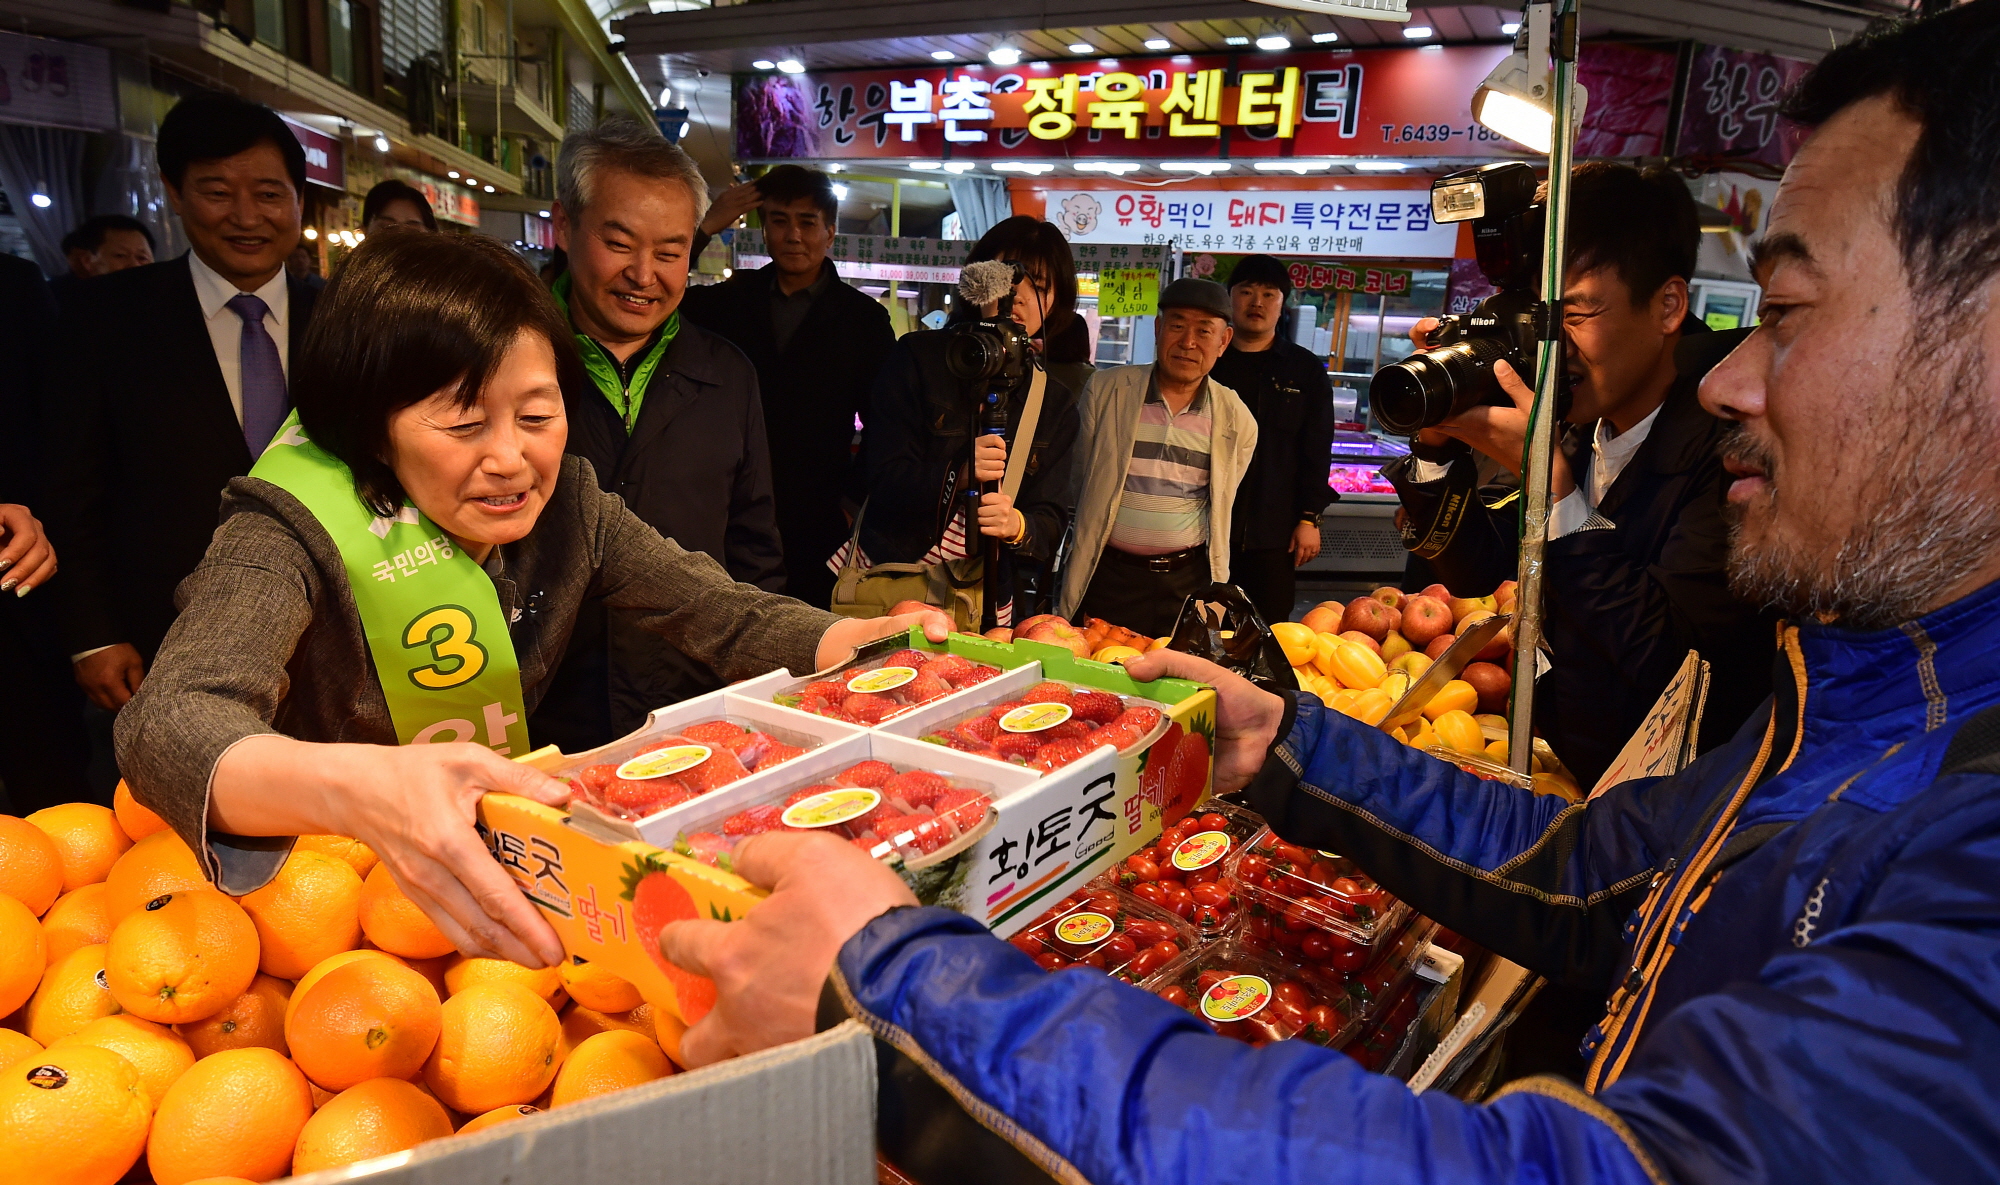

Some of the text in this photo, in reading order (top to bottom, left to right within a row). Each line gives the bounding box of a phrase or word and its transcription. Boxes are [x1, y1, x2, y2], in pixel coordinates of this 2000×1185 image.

[883, 75, 995, 142] 부촌
[1022, 66, 1300, 141] 정육센터
[1702, 57, 1780, 148] 한우
[1115, 194, 1431, 231] 유황먹인 돼지 특약전문점
[1232, 235, 1257, 251] 각종
[1263, 235, 1302, 251] 수입육
[1308, 236, 1364, 253] 염가판매
[1288, 262, 1407, 293] 암돼지 코너
[1470, 317, 1496, 326] Nikon
[1441, 493, 1462, 528] Nikon
[372, 534, 454, 583] 국민의당
[401, 603, 490, 691] 3
[1123, 766, 1166, 836] 딸기
[1074, 824, 1116, 860] Good
[577, 884, 627, 944] 딸기
